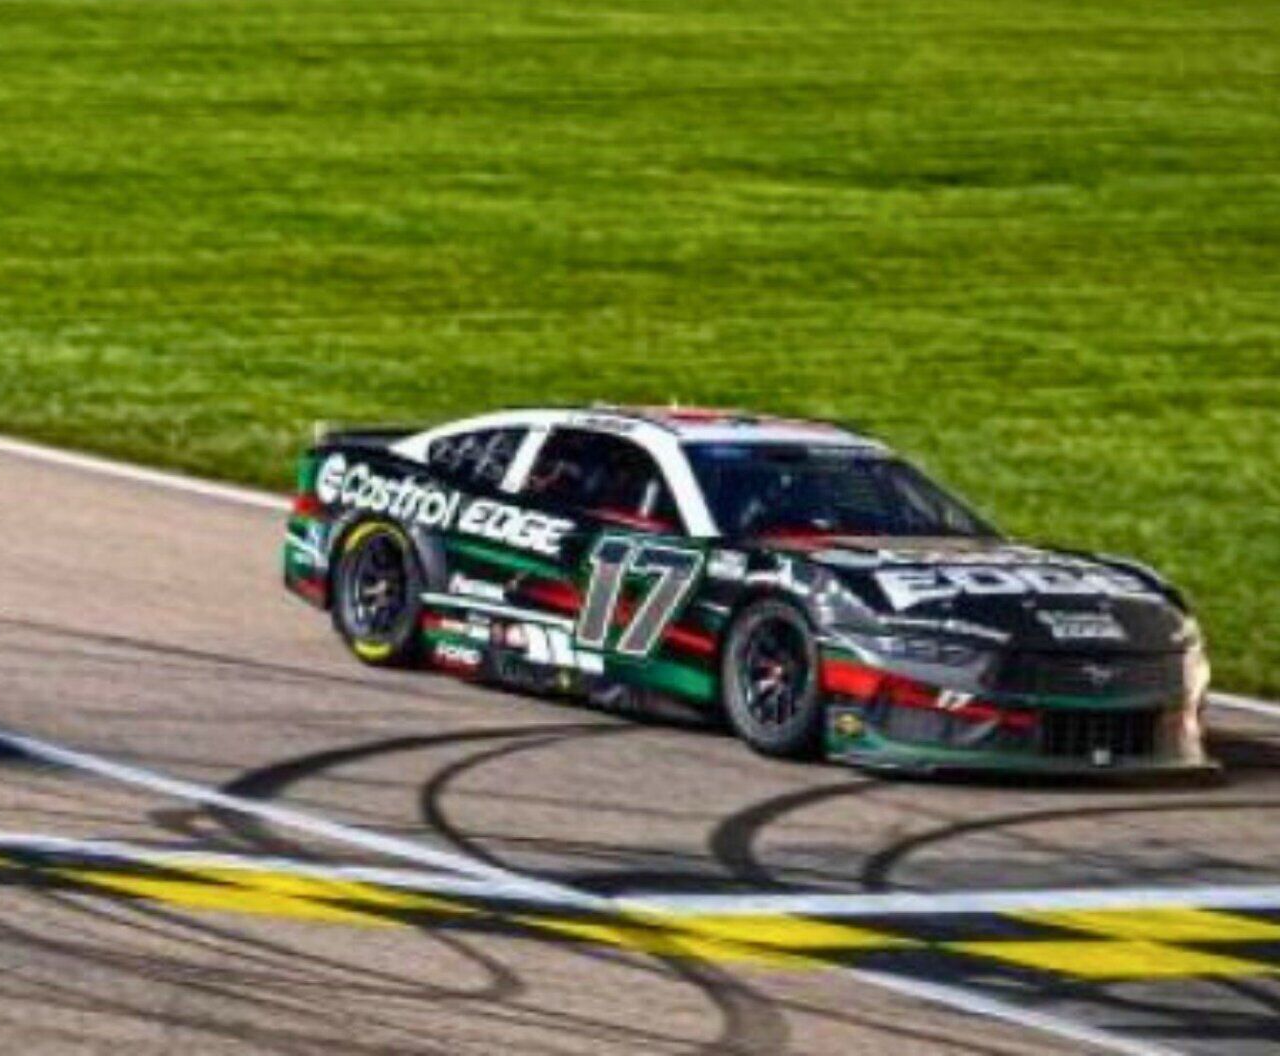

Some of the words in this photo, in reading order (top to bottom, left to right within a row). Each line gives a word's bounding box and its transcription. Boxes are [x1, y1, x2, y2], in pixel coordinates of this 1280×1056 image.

[340, 461, 460, 530] Castrol
[458, 497, 576, 557] EDGE
[576, 532, 704, 655] 17
